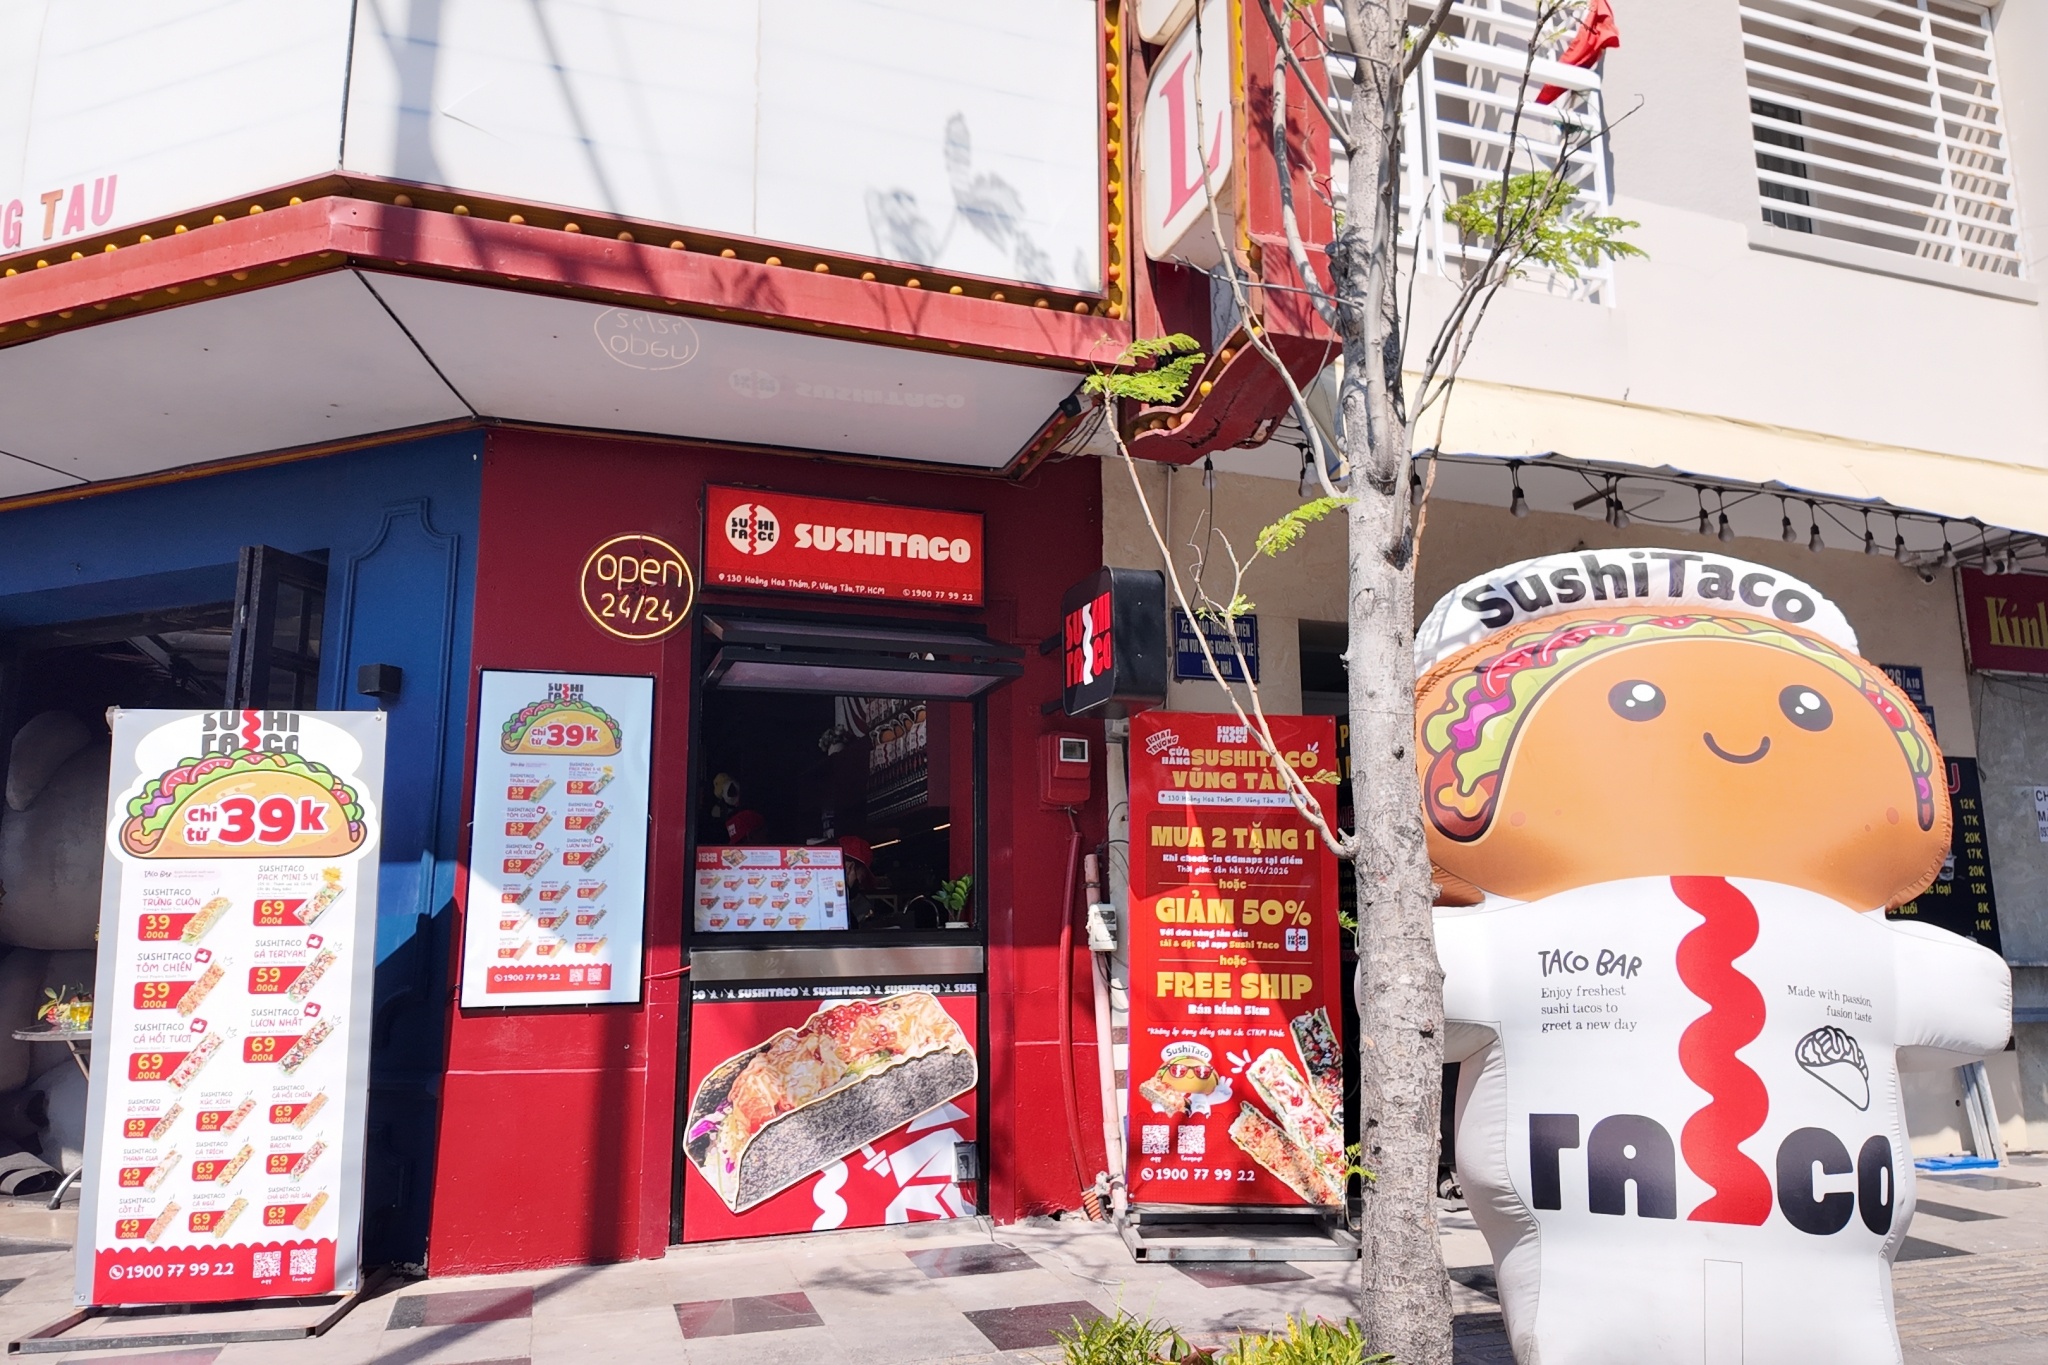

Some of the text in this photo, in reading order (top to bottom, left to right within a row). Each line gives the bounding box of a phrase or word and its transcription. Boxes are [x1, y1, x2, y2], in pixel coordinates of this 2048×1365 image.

[1159, 51, 1223, 228] L
[794, 523, 971, 564] SUSHITACO
[597, 554, 682, 591] open
[727, 574, 742, 582] 130
[911, 589, 973, 601] 1900 77 99 22
[1461, 550, 1816, 629] SushiTaco
[601, 593, 673, 623] 24/24
[1147, 731, 1170, 745] KHAI
[1172, 767, 1237, 789] VŨNG
[511, 787, 525, 795] 39
[570, 782, 584, 790] 69
[1959, 799, 1976, 810] 12K
[187, 797, 325, 843] Chỉ 39k
[569, 817, 583, 825] 59
[1962, 815, 1979, 826] 17K
[510, 823, 525, 831] 59
[187, 827, 210, 842] từ
[1151, 821, 1315, 855] MUA 2 TẶNG 1
[1964, 832, 1981, 844] 20K
[567, 852, 580, 861] 69
[1162, 853, 1178, 862] Khi
[1180, 854, 1223, 863] check-in
[1265, 855, 1278, 866] tại
[1966, 848, 1983, 860] 17K
[508, 860, 522, 869] 69
[1244, 866, 1289, 875] 30/4/2026
[257, 873, 301, 881] PACK MINI
[1968, 865, 1985, 877] 20K
[1218, 878, 1247, 892] hoặc
[1971, 883, 1987, 895] 12K
[143, 888, 192, 896] SUSHITACO
[261, 900, 285, 916] 69
[1155, 889, 1312, 926] GIẢM 50%
[1977, 903, 1990, 914] 8K
[146, 915, 171, 930] 39
[1975, 919, 1992, 931] 14K
[1211, 941, 1228, 950] app
[1229, 940, 1255, 949] Sushi
[137, 953, 192, 961] SUSHITACO
[269, 949, 307, 958] TERIYAKI
[1219, 954, 1247, 968] hoặc
[1538, 948, 1643, 980] TACO BAR
[256, 967, 281, 983] 59
[503, 973, 560, 982] 1900 77 99 22
[143, 982, 170, 999] 59
[1156, 971, 1313, 1000] FREE SHIP
[738, 987, 799, 999] SUSHITACO
[813, 985, 871, 996] SUSHITACO
[1541, 984, 1627, 1000] Enjoy freshest
[1787, 984, 1873, 1008] Made with passion,
[251, 1009, 300, 1017] SUSHITACO
[1188, 1001, 1270, 1016] Bán kính 5km
[1541, 1002, 1618, 1015] sushi tacos to
[1826, 1005, 1872, 1023] fusion taste
[134, 1024, 185, 1032] SUSHITACO
[1541, 1018, 1638, 1033] greet a new day
[1246, 1028, 1267, 1037] CTKM
[251, 1037, 276, 1052] 69
[1165, 1044, 1210, 1059] SushiTaco
[137, 1054, 163, 1070] 69
[275, 1105, 293, 1117] 69
[201, 1112, 219, 1124] 69
[128, 1120, 146, 1131] 69
[270, 1155, 289, 1166] 69
[123, 1168, 141, 1180] 49
[196, 1162, 214, 1174] 69
[1155, 1168, 1256, 1181] 1900 77 99 22
[193, 1213, 211, 1225] 69
[268, 1207, 286, 1219] 69
[121, 1220, 140, 1232] 49
[126, 1263, 234, 1279] 1900 77 99 22
